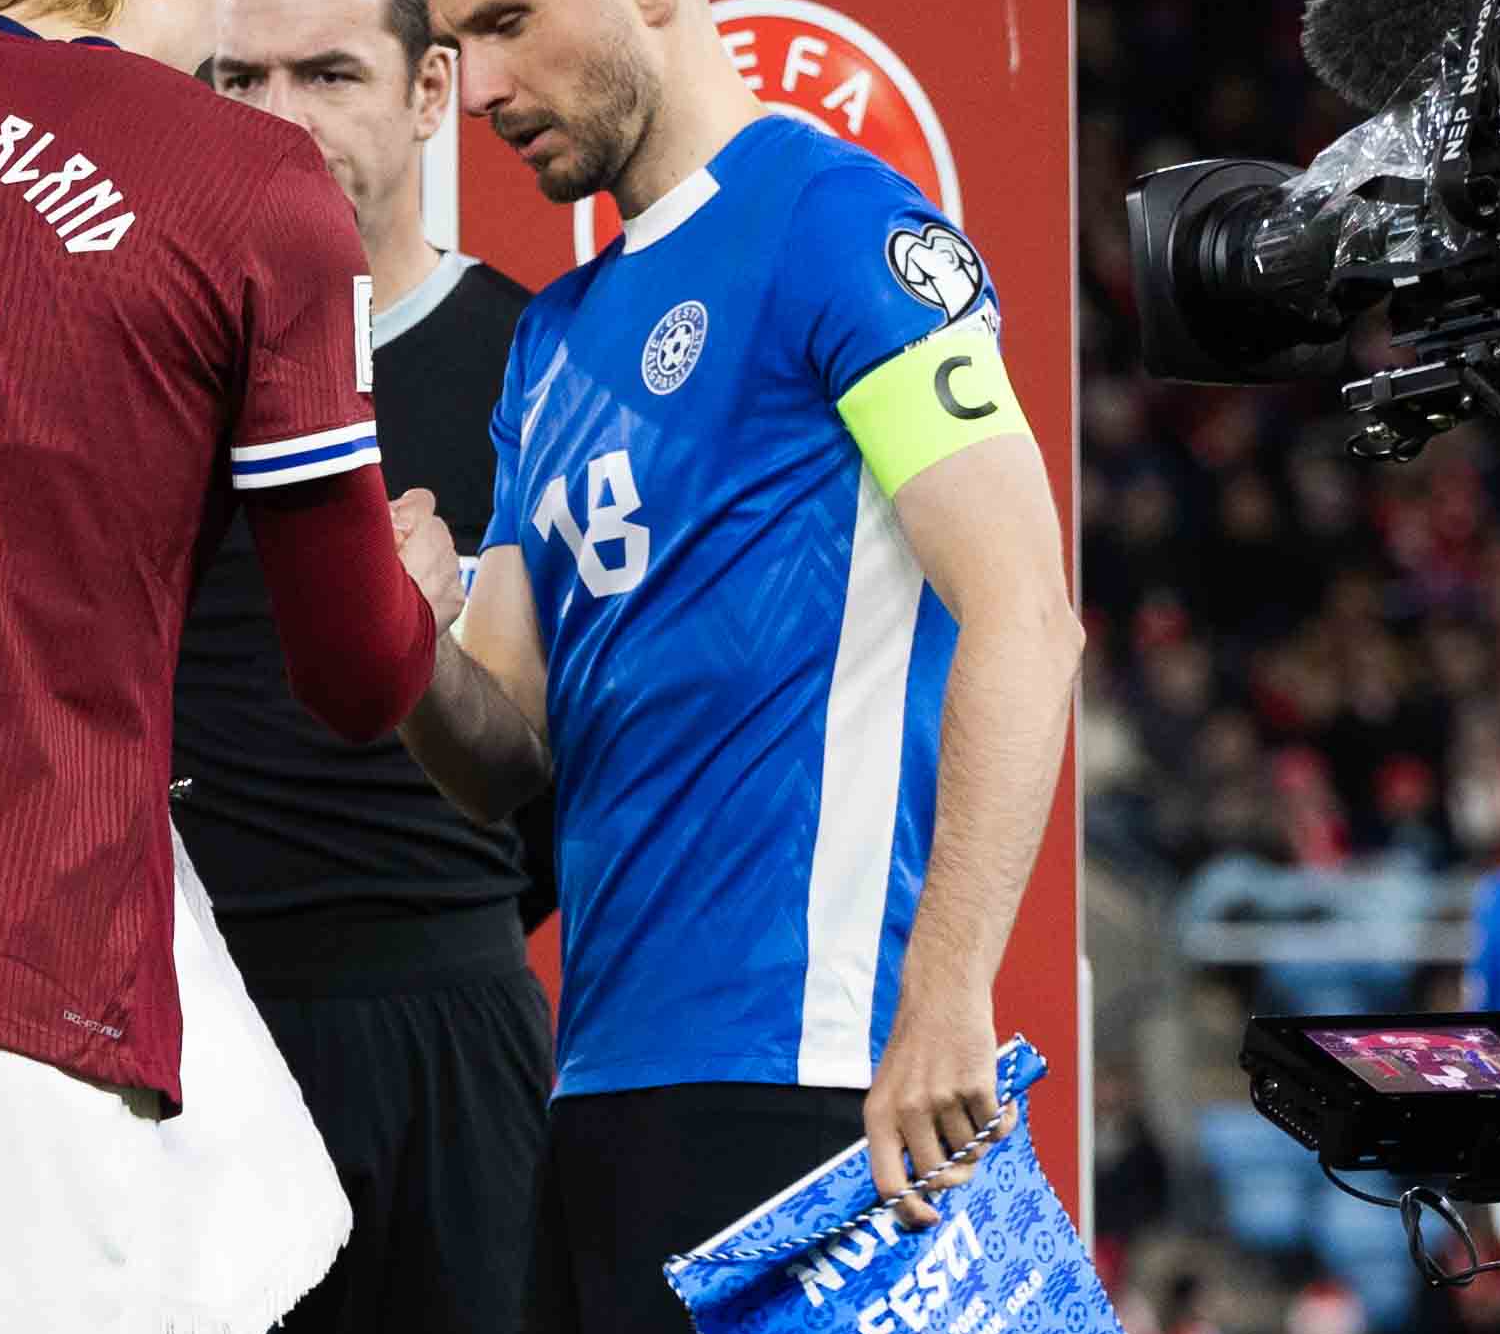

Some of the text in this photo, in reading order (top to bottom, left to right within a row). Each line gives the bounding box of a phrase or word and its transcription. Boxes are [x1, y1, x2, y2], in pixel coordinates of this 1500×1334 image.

[725, 29, 873, 136] EFA
[934, 355, 998, 420] C
[532, 449, 651, 605] 18
